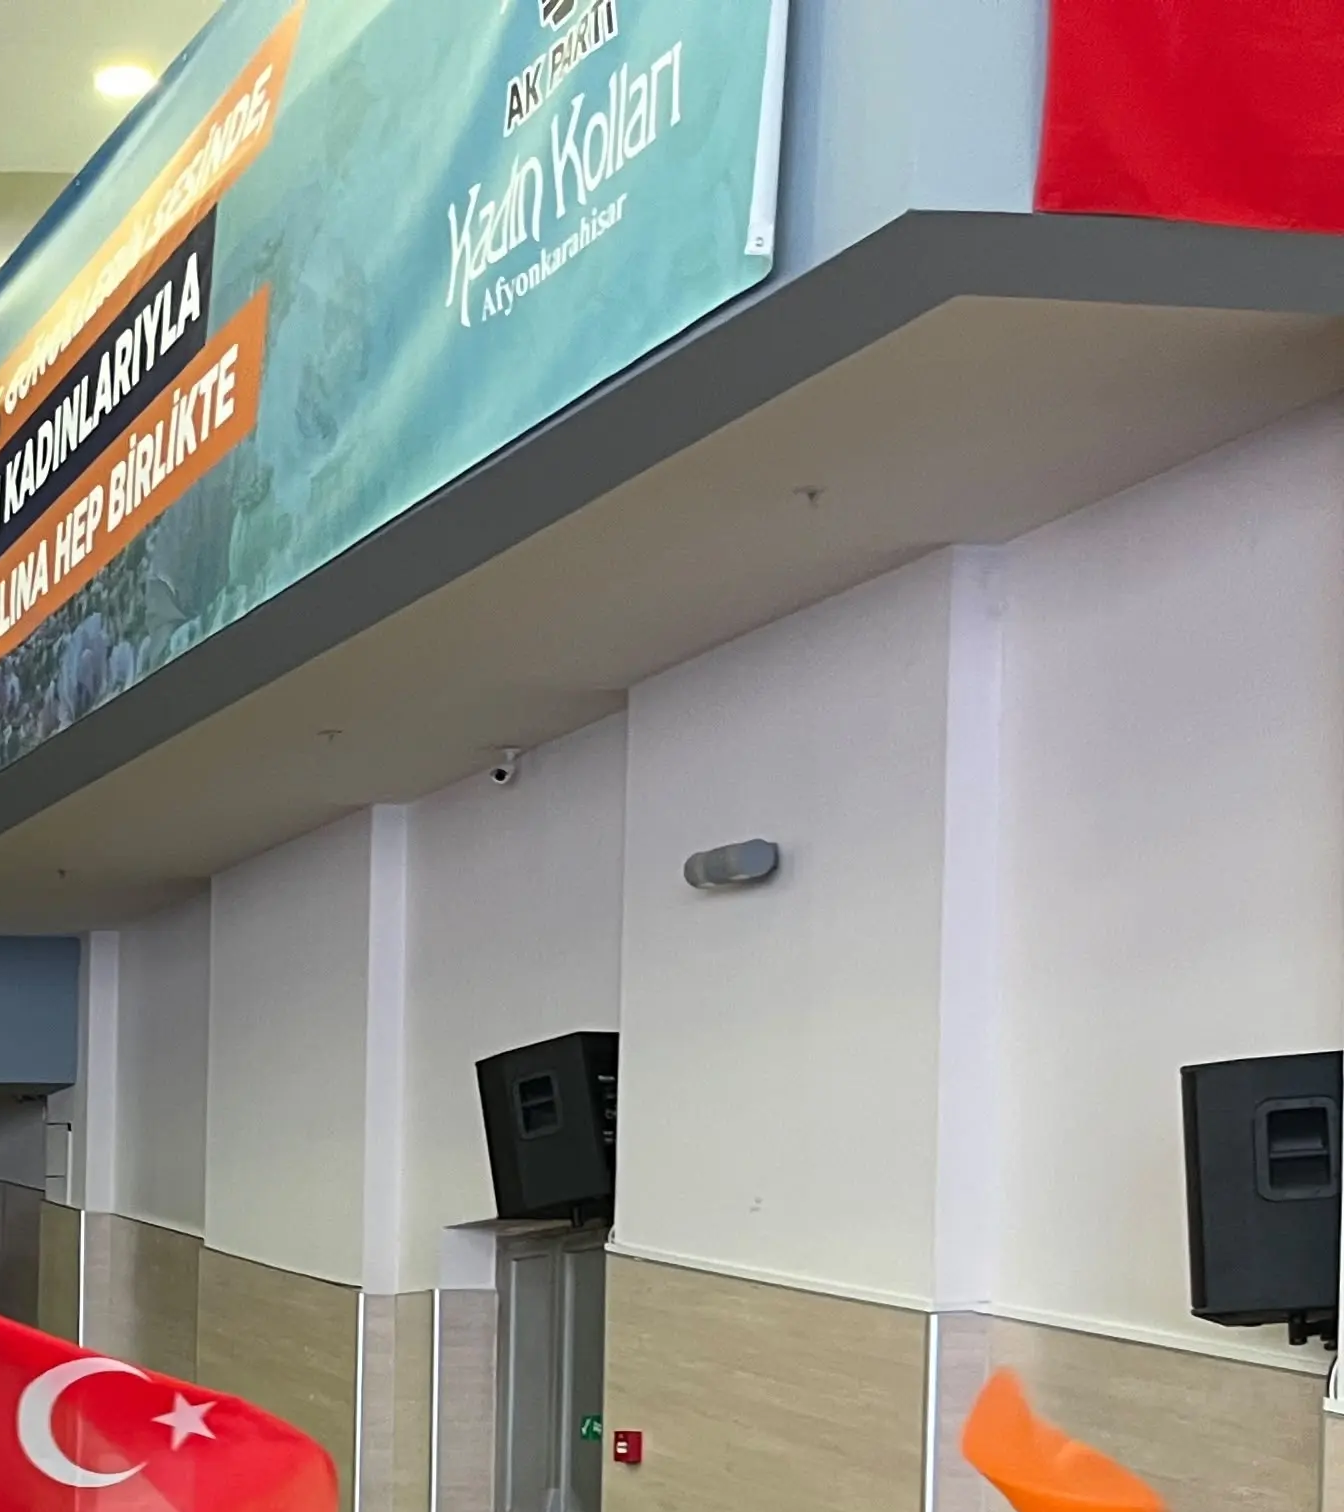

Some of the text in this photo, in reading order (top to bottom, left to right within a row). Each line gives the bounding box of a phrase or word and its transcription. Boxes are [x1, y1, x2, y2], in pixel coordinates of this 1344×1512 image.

[445, 41, 682, 327] Kadın Kolları
[507, 61, 541, 132] AK
[480, 192, 629, 322] Afyonkarahisar
[3, 252, 201, 524] KADINLARIYLA
[53, 483, 103, 585] HEP
[106, 343, 239, 534] BİRLİKTE
